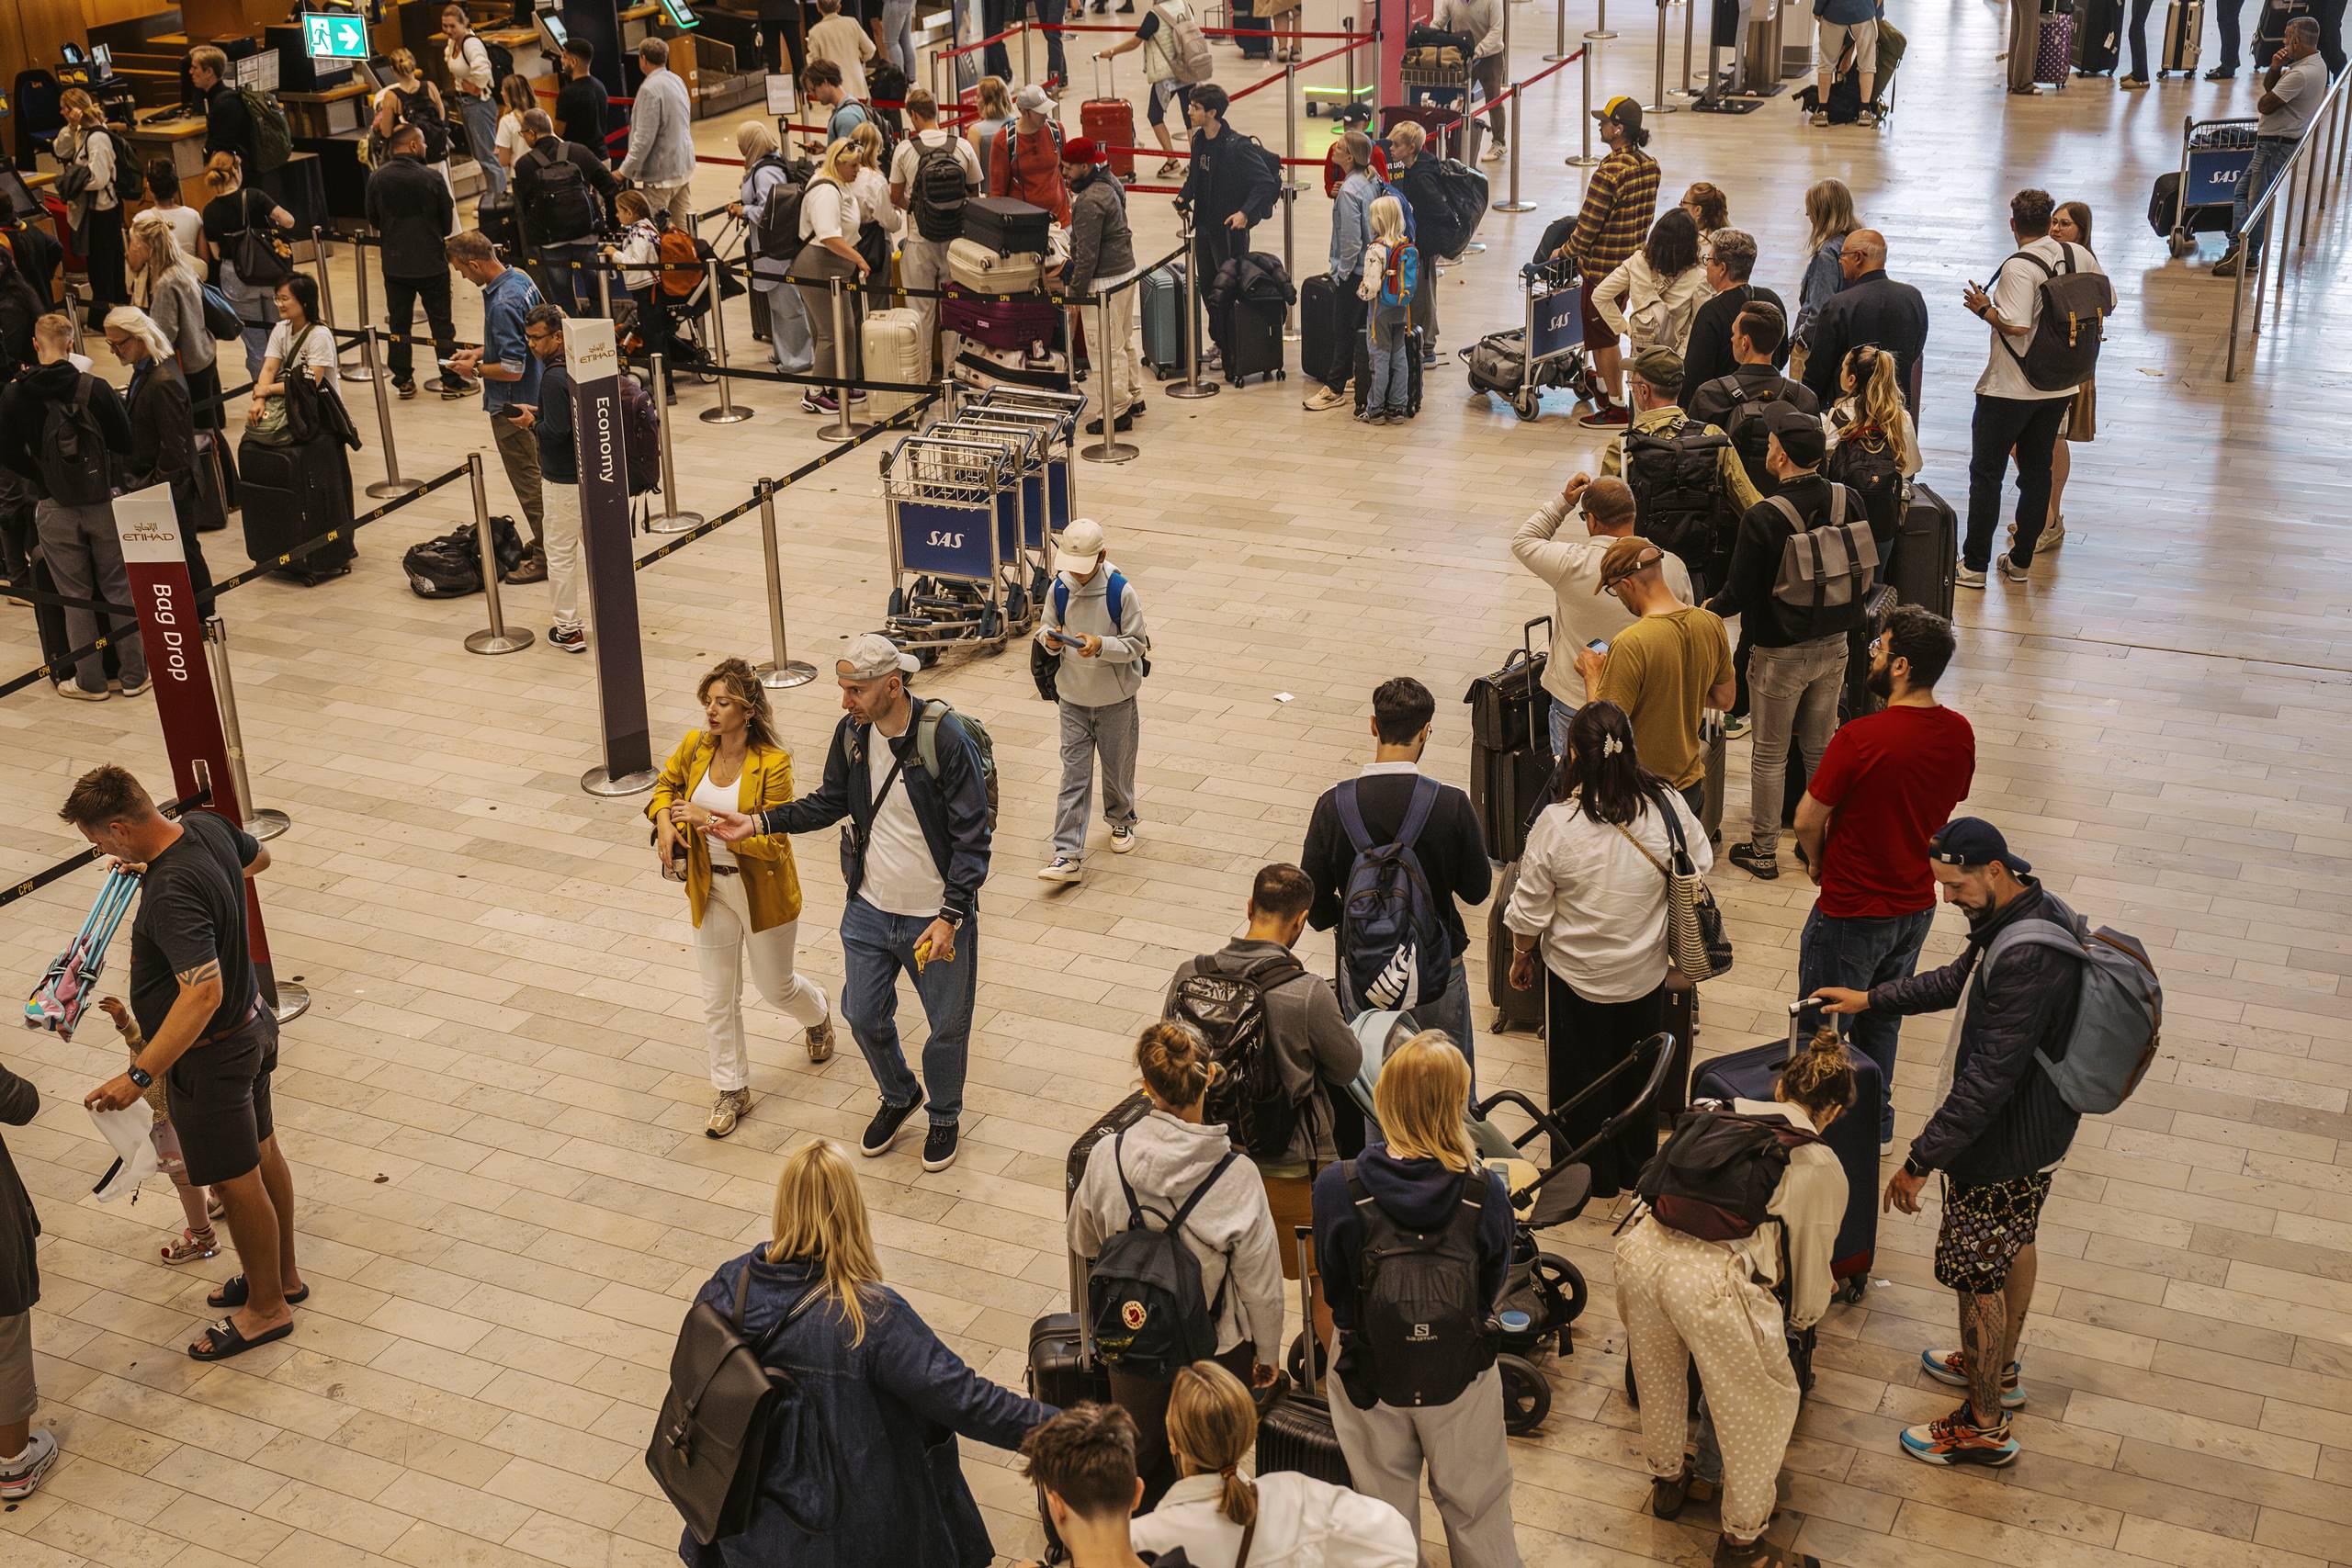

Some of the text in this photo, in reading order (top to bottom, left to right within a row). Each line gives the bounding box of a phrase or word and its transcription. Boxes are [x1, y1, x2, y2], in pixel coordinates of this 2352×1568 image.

[2209, 170, 2241, 184] SAS
[948, 291, 958, 299] CPH
[1547, 311, 1570, 332] SAS
[580, 350, 616, 365] ETIHAD
[596, 396, 615, 483] Economy
[738, 504, 747, 515] CPH
[712, 518, 722, 529] CPH
[122, 533, 175, 542] ETIHAD
[328, 530, 338, 541] CPH
[685, 532, 695, 543] CPH
[926, 530, 965, 548] SAS
[659, 547, 670, 558] CPH
[279, 554, 290, 565] CPH
[230, 577, 240, 588] CPH
[153, 583, 188, 682] Bag Drop
[96, 638, 107, 649] CPH
[39, 666, 51, 677] CPH
[18, 881, 34, 896] CPH
[1364, 943, 1410, 1011] NIKE
